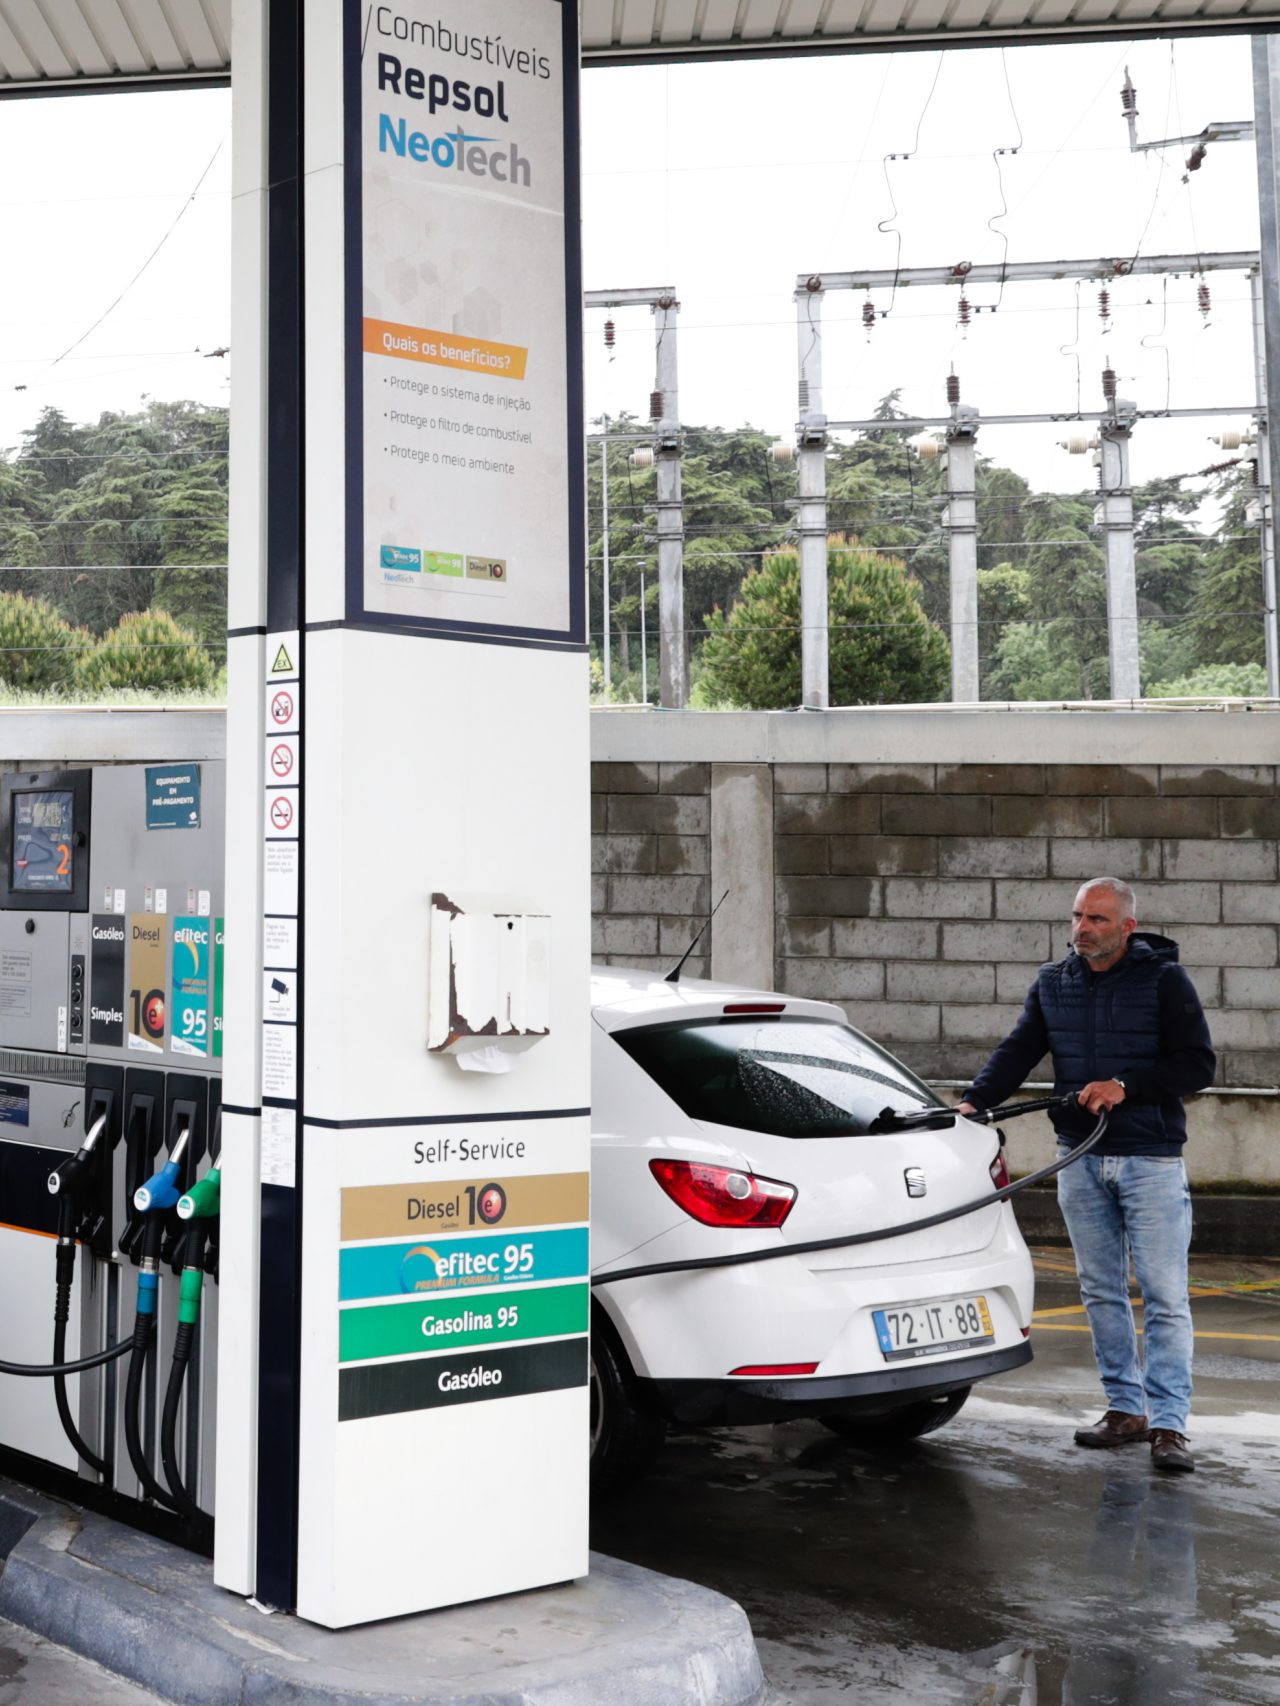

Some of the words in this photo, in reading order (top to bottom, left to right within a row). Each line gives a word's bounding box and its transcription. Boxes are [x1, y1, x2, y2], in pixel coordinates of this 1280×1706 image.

[377, 7, 551, 79] Combustíveis
[378, 52, 509, 122] Repsol
[383, 332, 418, 352] Quais
[421, 342, 437, 356] os
[439, 342, 511, 369] benefícios?
[390, 376, 429, 396] Protege
[432, 384, 439, 395] o
[441, 386, 480, 403] sistema
[482, 392, 494, 405] de
[496, 395, 531, 411] injeção
[390, 410, 428, 430] Protege
[429, 418, 436, 429] o
[438, 417, 460, 433] filtro
[462, 421, 474, 435] de
[476, 426, 532, 444] combustível
[390, 445, 429, 464] Protege
[432, 452, 439, 463] o
[441, 454, 466, 468] meio
[469, 458, 515, 475] ambiente
[56, 844, 70, 875] 2
[92, 927, 125, 941] Gasóleo
[132, 926, 160, 941] Diesel
[174, 927, 208, 944] efitec
[91, 1006, 123, 1025] Simples
[182, 1008, 207, 1037] 95
[414, 1137, 526, 1164] Self-Service
[407, 1195, 460, 1220] Diesel
[435, 1252, 500, 1278] efitec
[503, 1243, 534, 1274] 95
[421, 1309, 493, 1337] Gasolina
[497, 1305, 519, 1328] 95
[438, 1366, 502, 1392] Gasóleo
